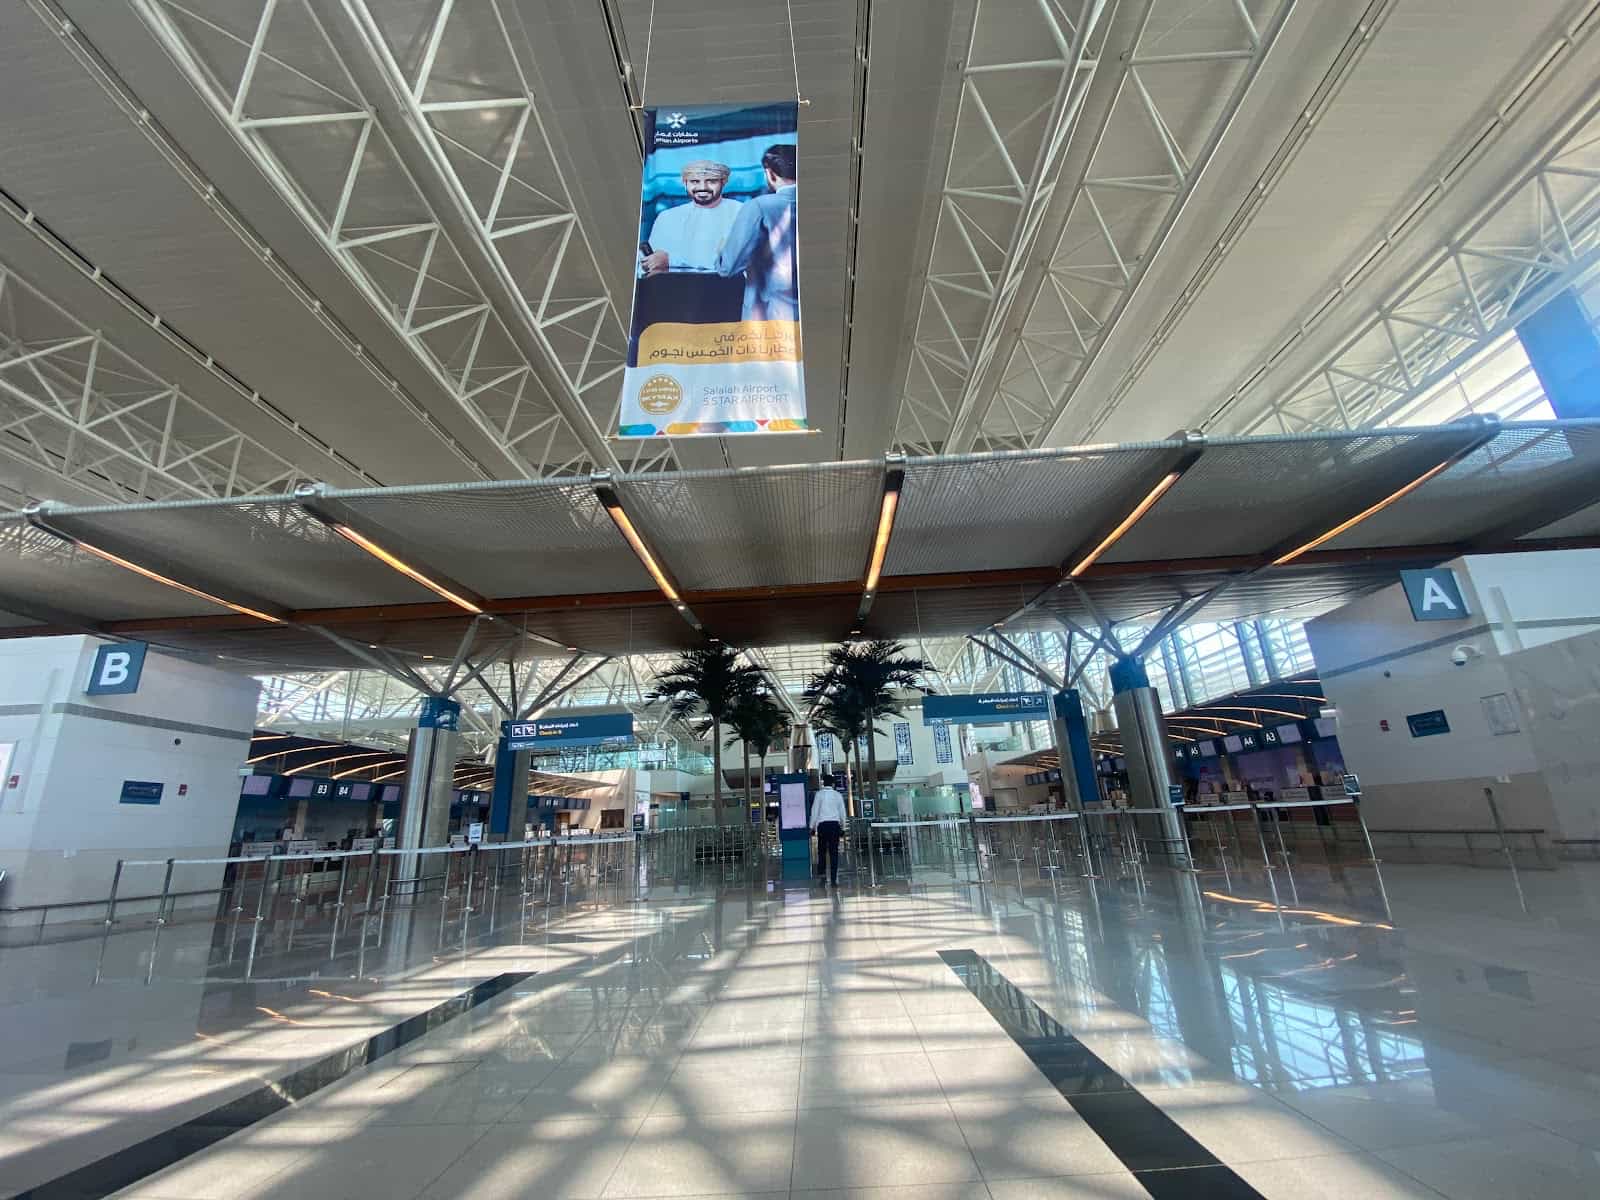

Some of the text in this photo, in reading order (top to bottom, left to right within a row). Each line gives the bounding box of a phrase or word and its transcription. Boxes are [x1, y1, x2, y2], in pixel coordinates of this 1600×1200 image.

[654, 136, 699, 145] man Airports
[713, 333, 735, 345] في
[648, 346, 684, 360] نجوم
[686, 345, 733, 358] الخمس
[741, 383, 778, 394] Airport
[741, 393, 789, 404] AIRPORT
[1422, 577, 1457, 611] A
[99, 652, 131, 686] B
[1244, 736, 1254, 746] A4
[1265, 732, 1275, 742] A3
[317, 784, 328, 794] B3
[338, 786, 349, 796] B4
